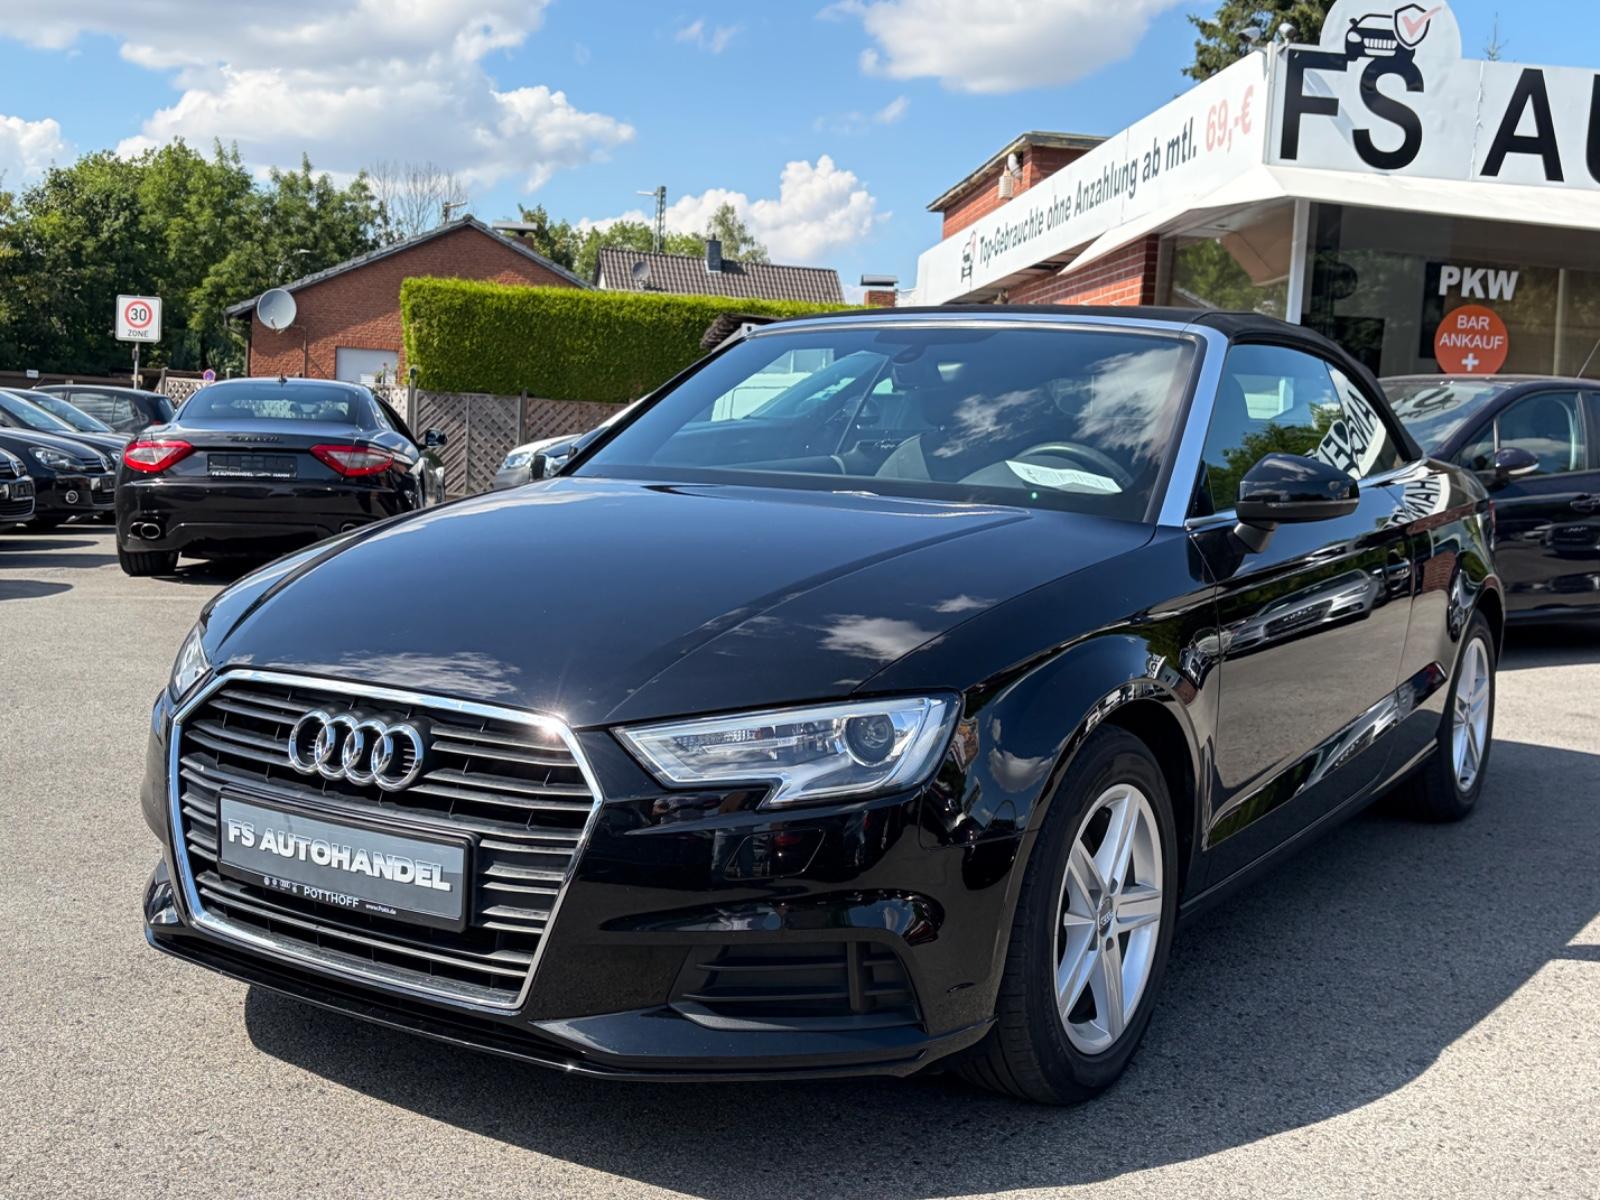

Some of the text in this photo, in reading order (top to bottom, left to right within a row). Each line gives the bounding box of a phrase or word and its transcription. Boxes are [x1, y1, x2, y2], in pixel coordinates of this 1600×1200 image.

[1280, 49, 1600, 184] FS A
[980, 206, 1044, 268] Top-Gebrauchte
[1047, 194, 1072, 231] ohne
[1074, 158, 1138, 216] Anzahlung
[1142, 137, 1161, 183] ab
[1165, 116, 1197, 171] mtl.
[1438, 265, 1519, 301] PKW
[130, 308, 147, 321] 30
[1457, 315, 1490, 330] BAR
[128, 329, 149, 337] ZONE
[1440, 332, 1504, 350] ANKAUF
[228, 818, 452, 891] FS AUTOHANDEL
[303, 885, 360, 908] POTTHOFF
